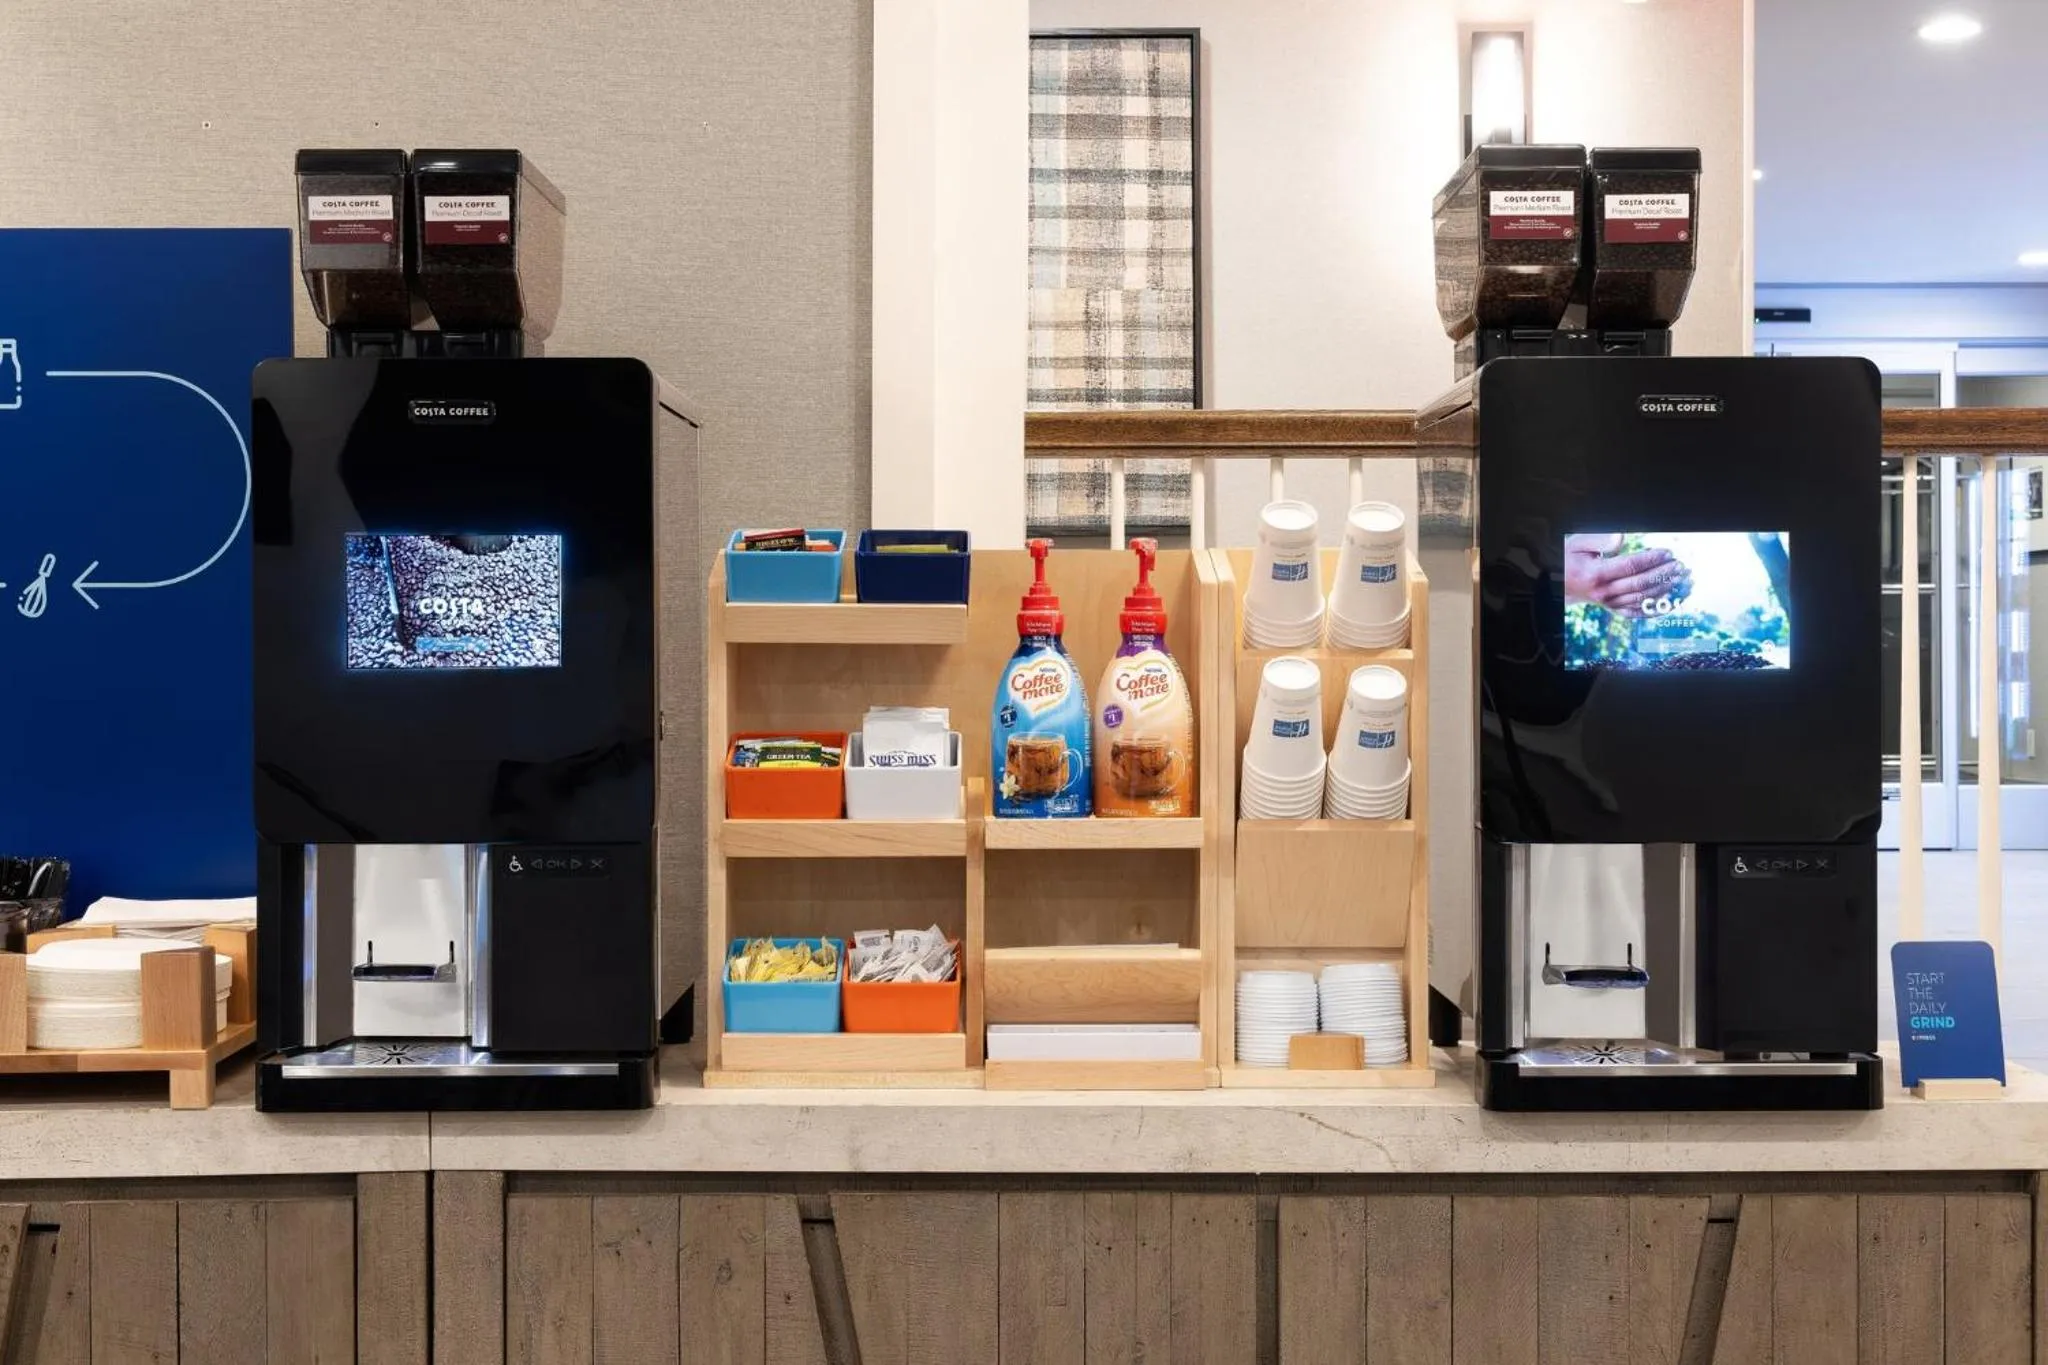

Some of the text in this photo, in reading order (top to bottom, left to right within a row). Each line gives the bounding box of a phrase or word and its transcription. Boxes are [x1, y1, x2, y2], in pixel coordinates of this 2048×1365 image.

[1504, 195, 1561, 203] COSTA COFFEE
[414, 407, 489, 417] COSTA COFFEE
[1641, 403, 1717, 413] COSTA COFFEE
[419, 597, 487, 617] COSTA
[1657, 619, 1695, 628] COFFEE
[1011, 673, 1062, 691] Coffee
[1116, 673, 1167, 691] Coffee
[1023, 683, 1064, 700] mate
[1128, 683, 1169, 700] mate
[1906, 972, 1945, 985] START
[1908, 987, 1933, 1000] THE
[1909, 1001, 1947, 1015] DAILY
[1911, 1016, 1955, 1029] GRIND
